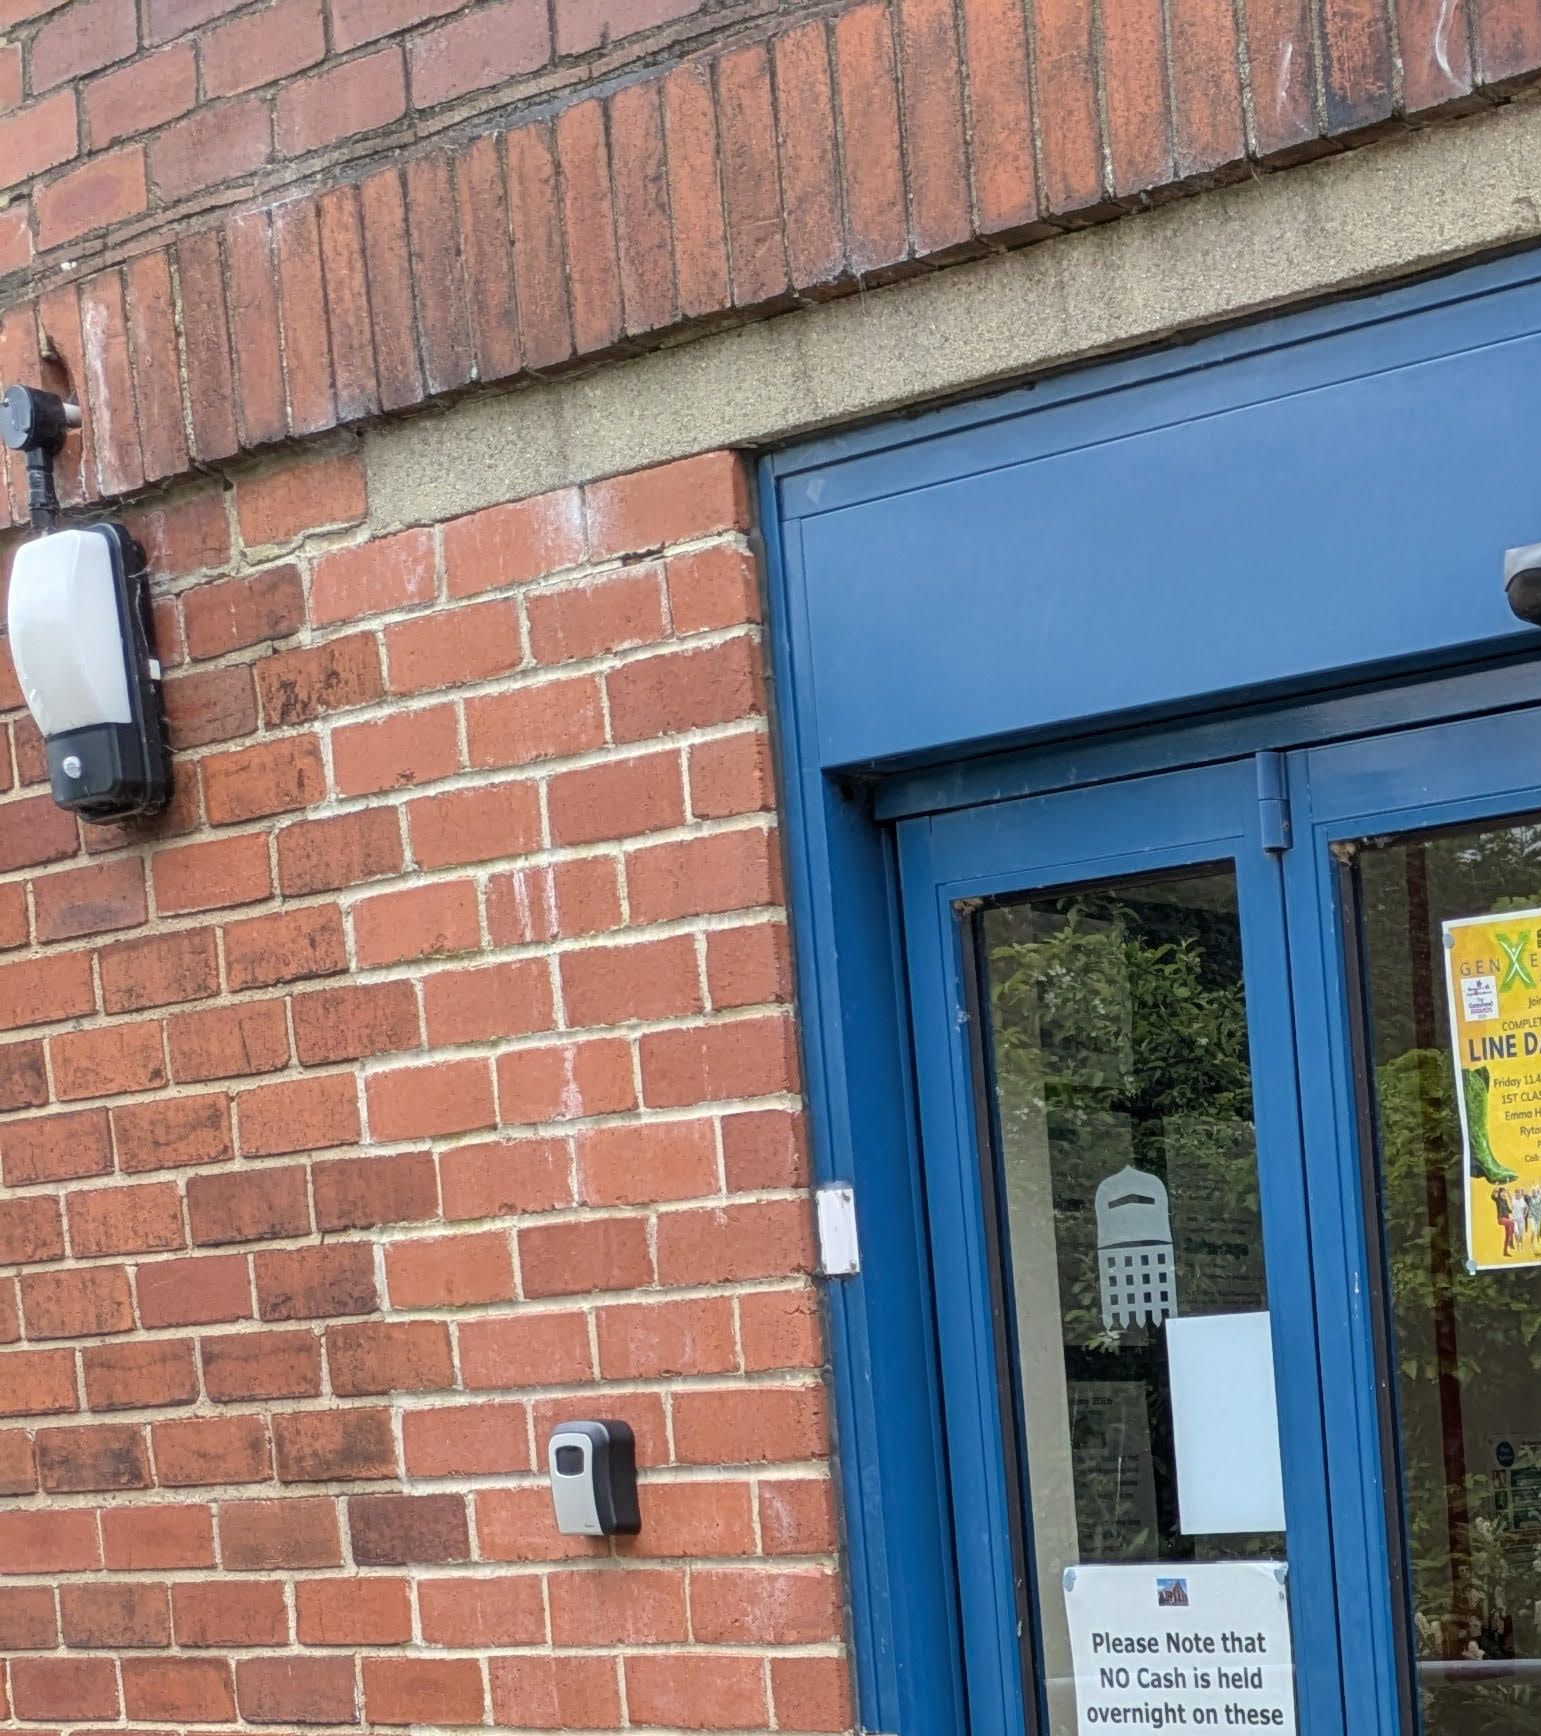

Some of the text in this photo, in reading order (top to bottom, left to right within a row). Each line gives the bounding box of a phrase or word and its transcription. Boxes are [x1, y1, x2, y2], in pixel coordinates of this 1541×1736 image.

[1468, 1034, 1518, 1062] LINE
[1494, 1077, 1521, 1089] Friday
[1502, 1093, 1518, 1105] 1ST
[1505, 1111, 1533, 1121] Emma
[1091, 1631, 1267, 1654] Please Note that
[1100, 1667, 1263, 1690] NO Cash is held
[1087, 1702, 1284, 1729] overnight on these
